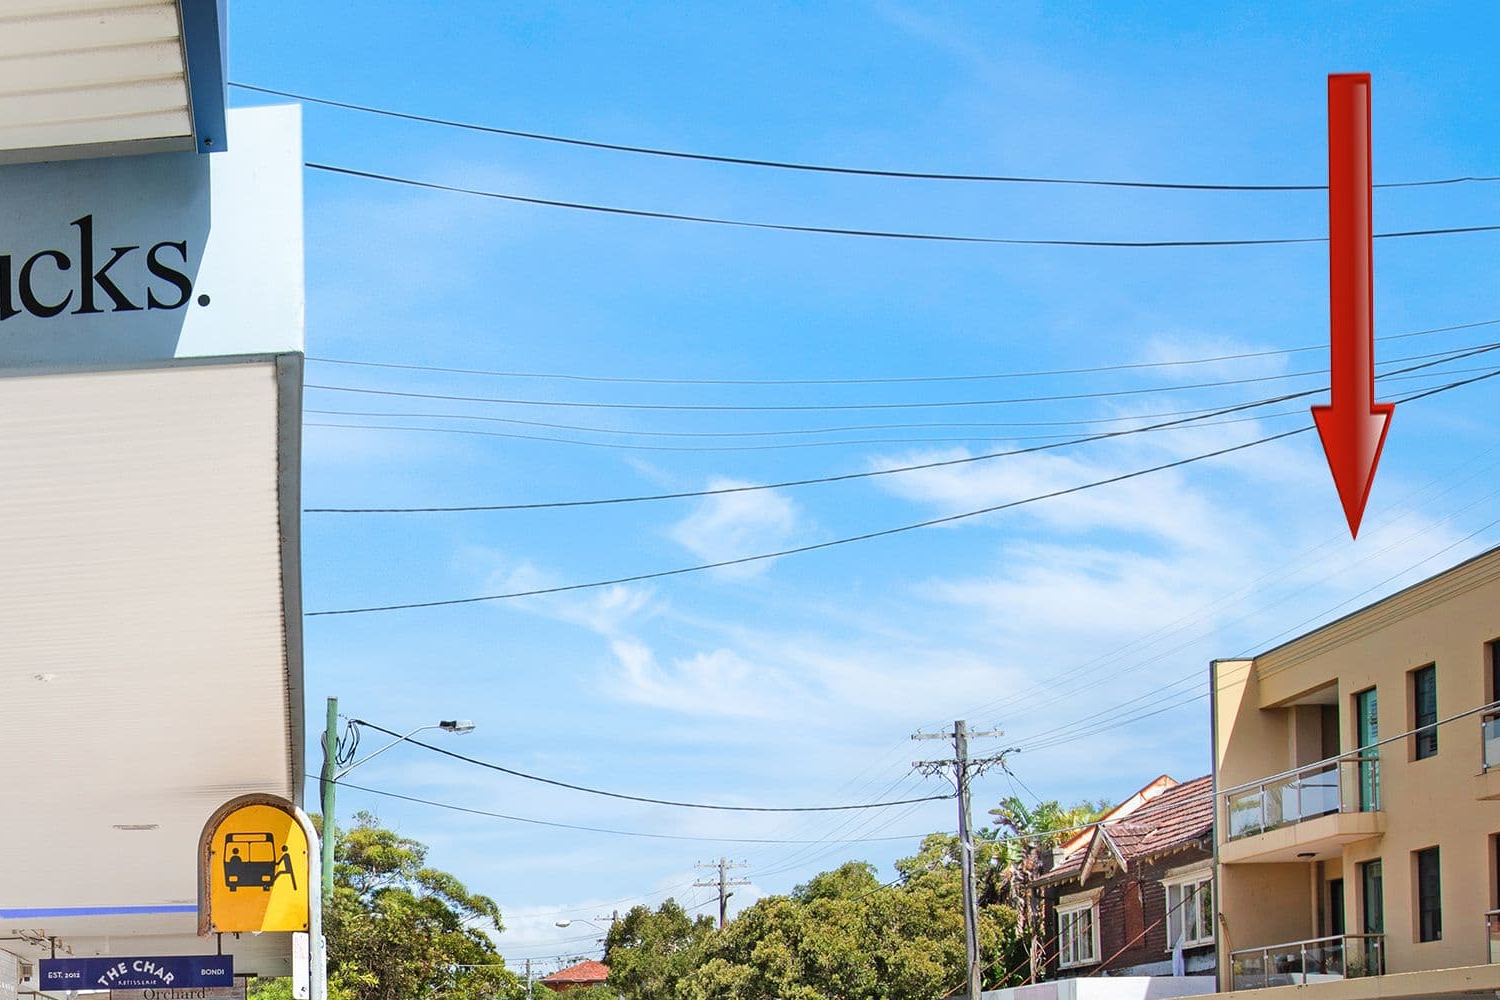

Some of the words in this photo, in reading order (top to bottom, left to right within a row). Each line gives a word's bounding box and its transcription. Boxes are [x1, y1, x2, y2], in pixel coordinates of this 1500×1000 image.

[47, 971, 64, 980] EST.
[97, 961, 129, 987] THE
[132, 959, 176, 985] CHAR
[200, 968, 225, 976] BONDI
[143, 987, 206, 1000] Orchard
